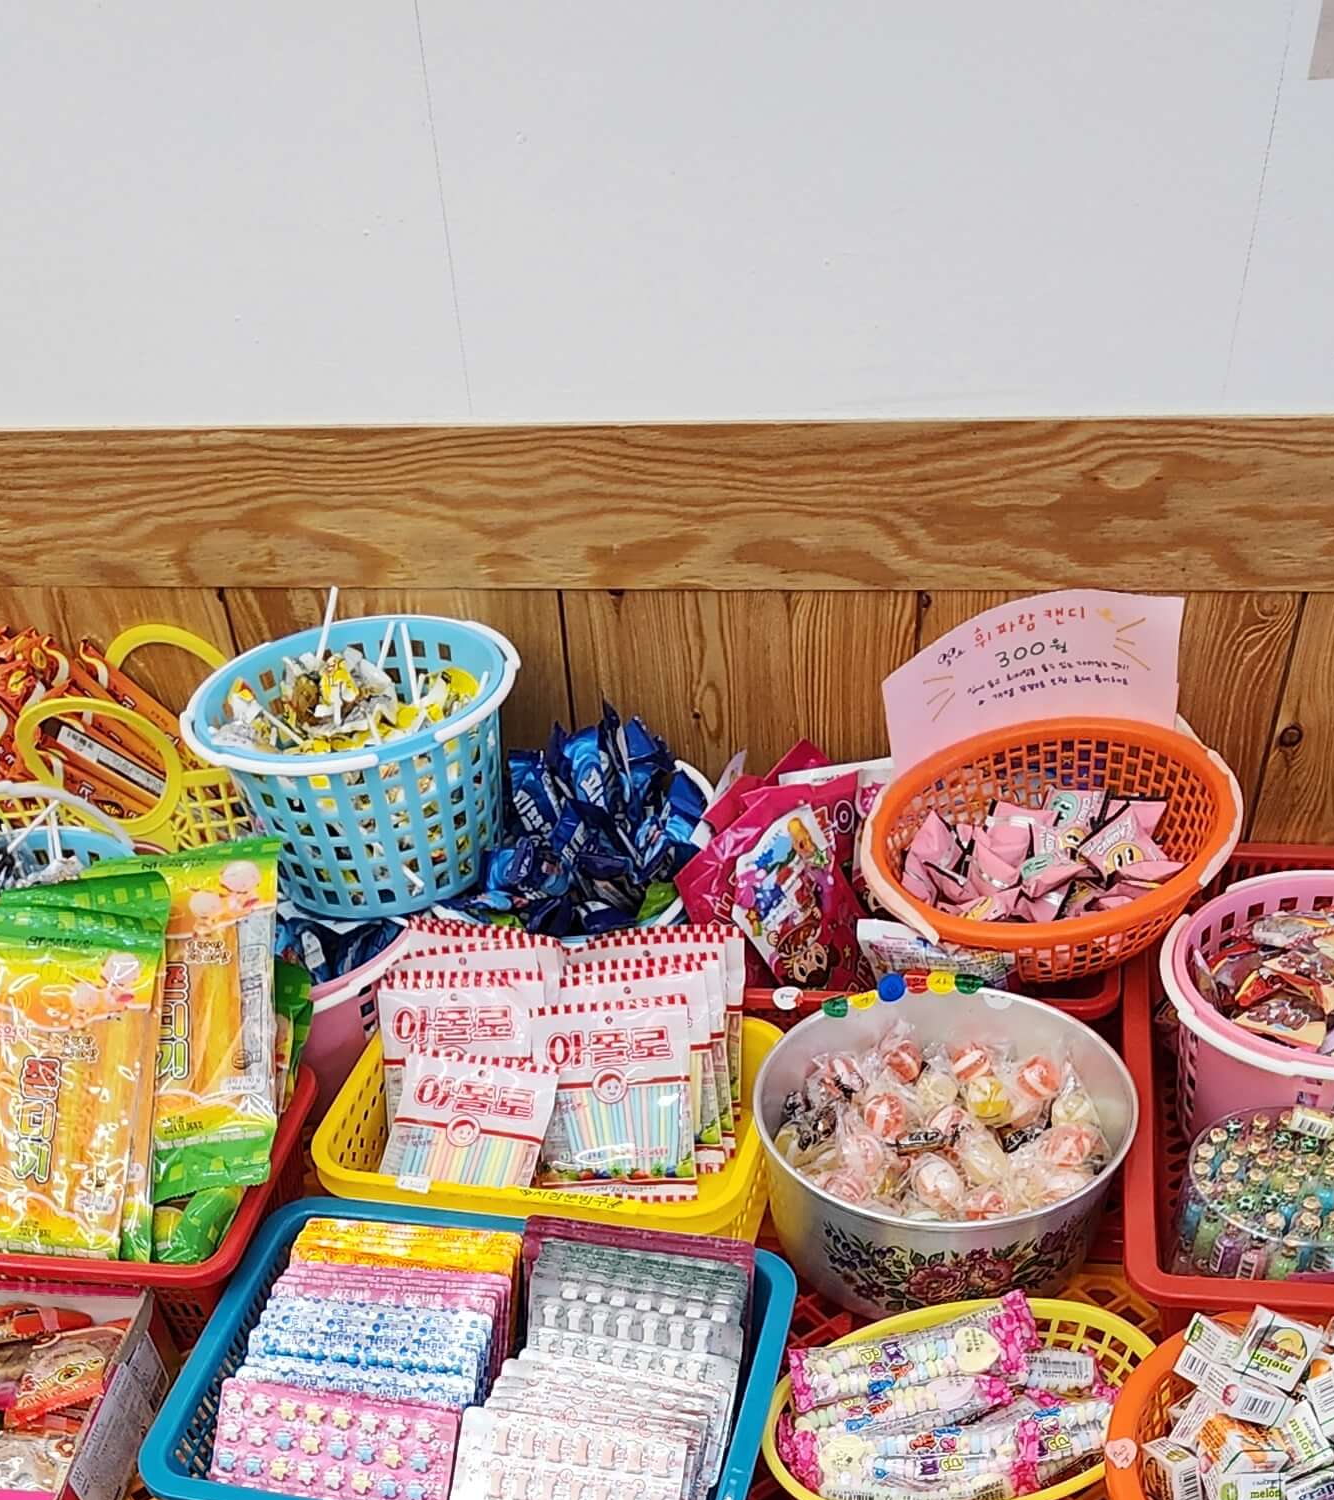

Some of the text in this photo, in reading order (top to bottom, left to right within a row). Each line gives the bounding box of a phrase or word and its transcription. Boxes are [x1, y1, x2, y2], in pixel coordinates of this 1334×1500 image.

[1042, 605, 1086, 627] 캔디
[995, 638, 1069, 669] 300원
[391, 1005, 517, 1046] 아폴로
[545, 1024, 674, 1072] 아폴로
[414, 1072, 539, 1122] 아폴로
[1250, 1350, 1294, 1375] melon
[1289, 1417, 1315, 1458] melon
[1250, 1487, 1281, 1500] melon
